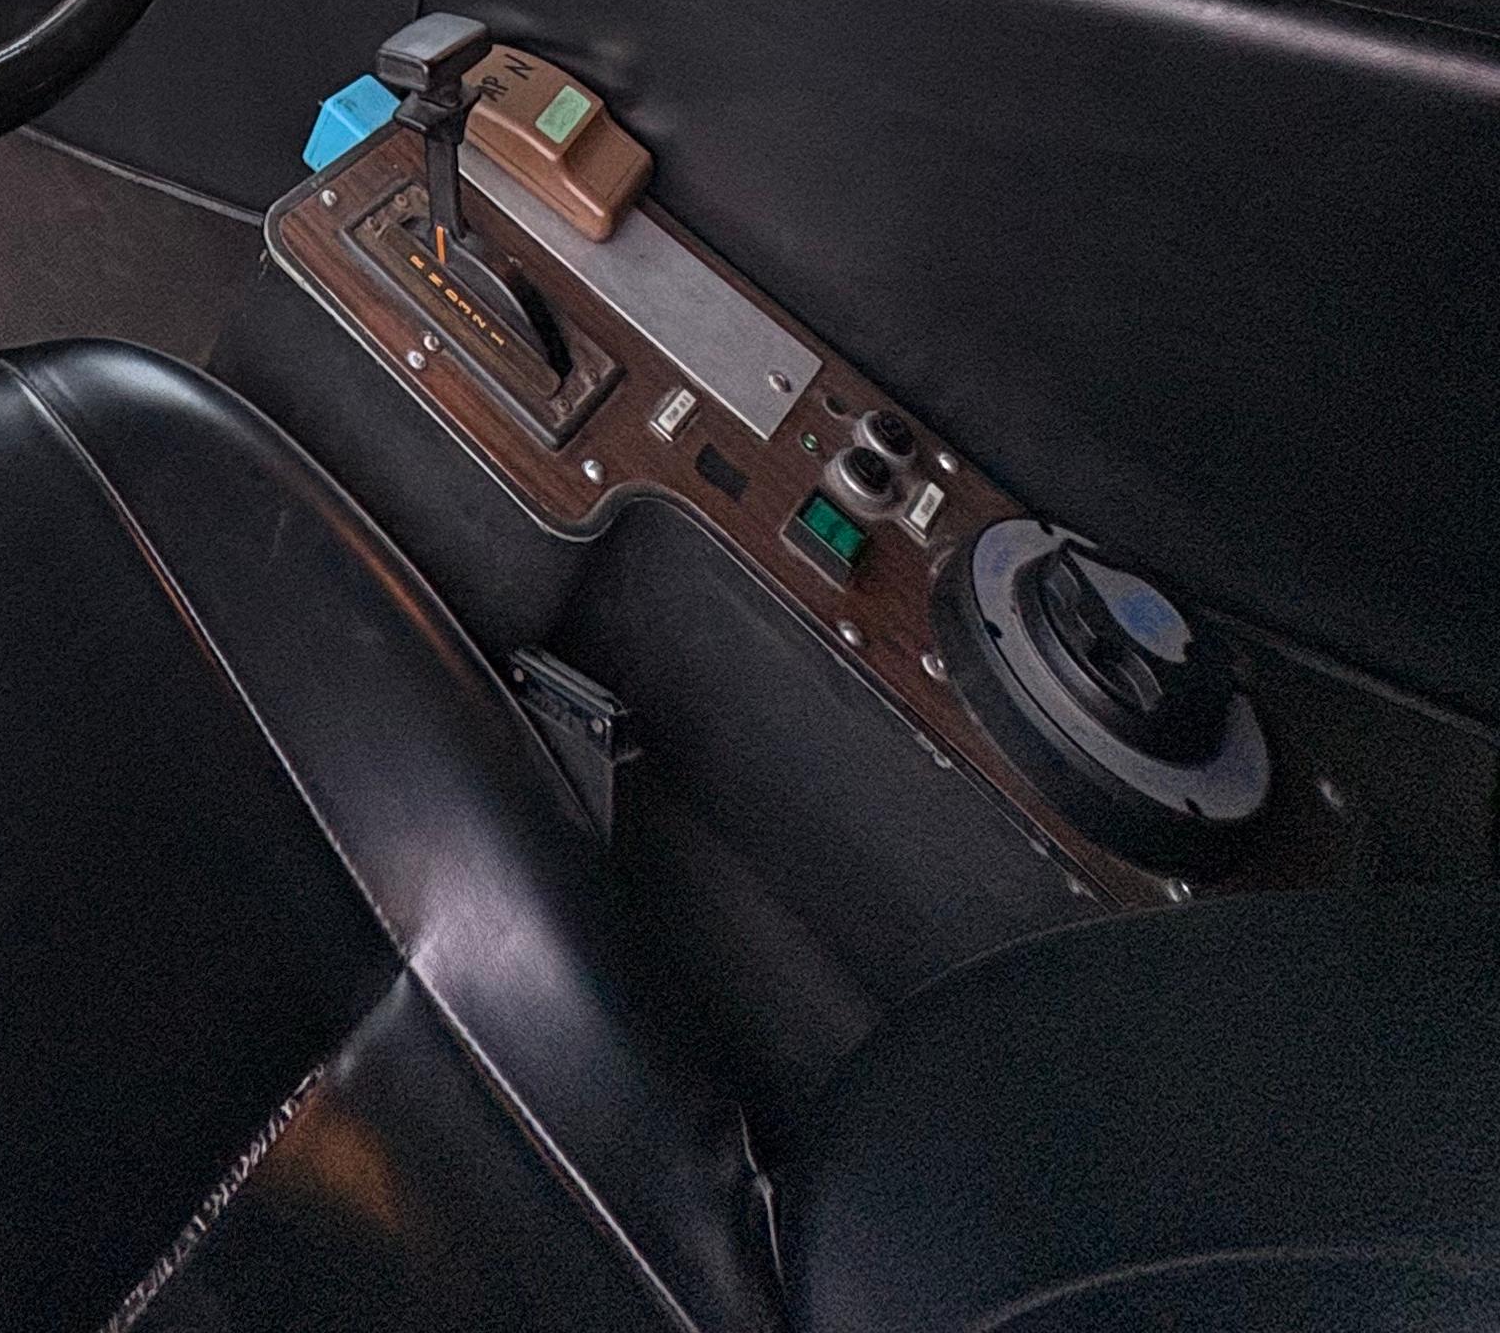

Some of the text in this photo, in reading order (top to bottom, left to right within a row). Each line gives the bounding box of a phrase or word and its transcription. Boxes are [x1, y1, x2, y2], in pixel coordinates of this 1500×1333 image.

[410, 255, 505, 346] R N D 3 2 1
